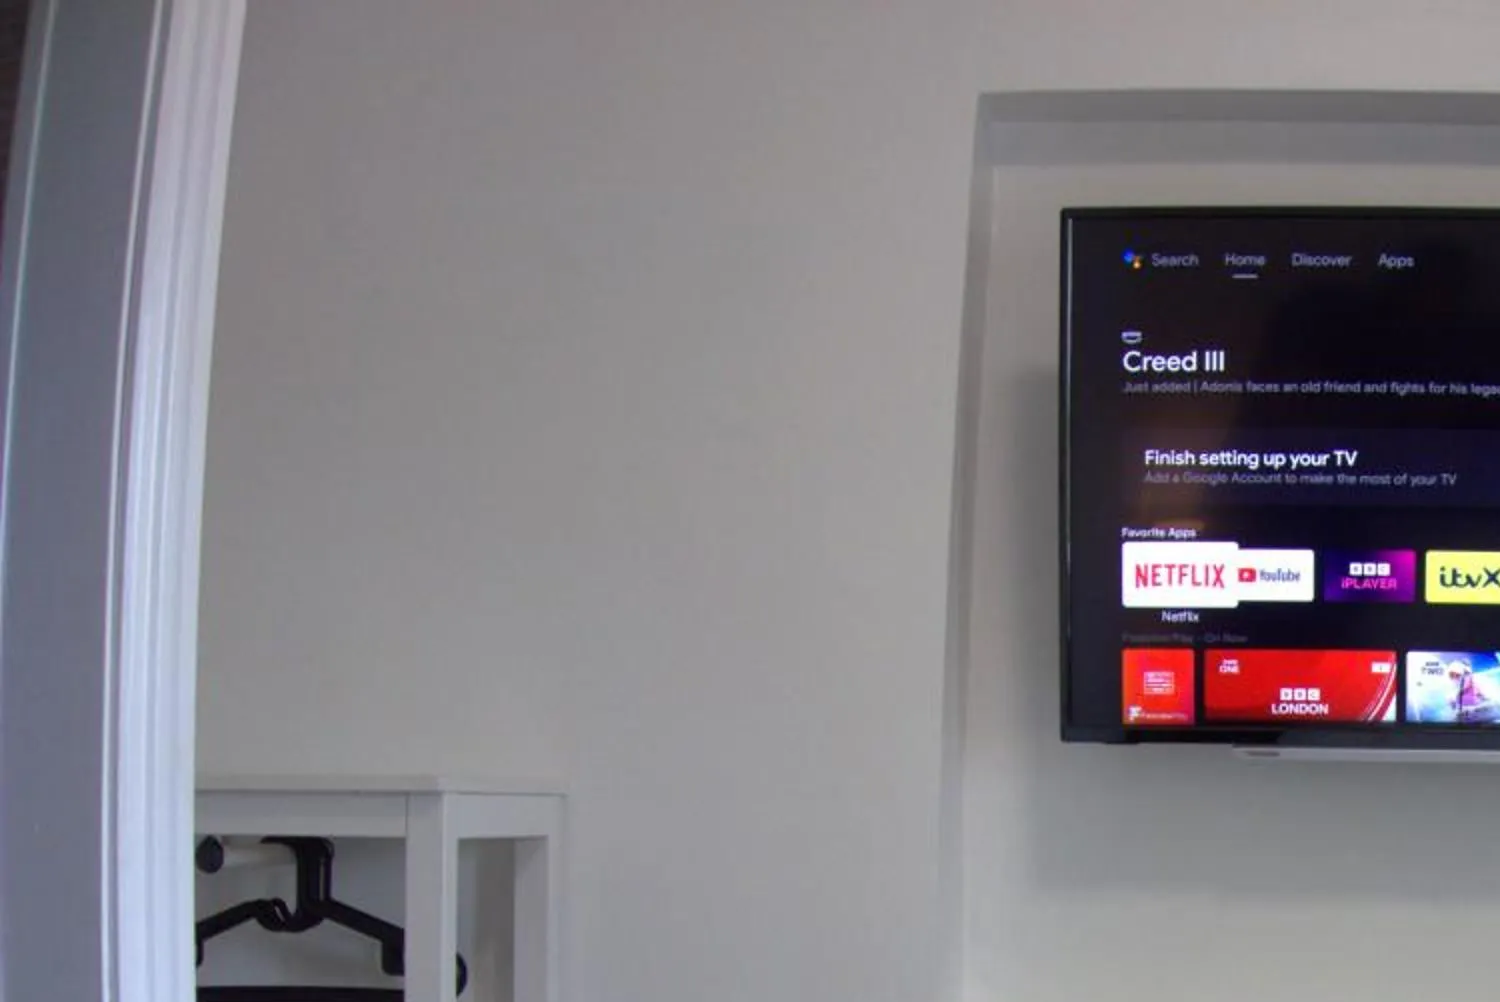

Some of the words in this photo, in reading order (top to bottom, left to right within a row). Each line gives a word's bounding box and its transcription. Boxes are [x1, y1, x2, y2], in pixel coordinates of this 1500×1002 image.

[1151, 253, 1199, 268] Search
[1224, 252, 1266, 267] Home
[1291, 253, 1352, 268] Discover
[1378, 253, 1415, 270] Apps
[1122, 350, 1198, 372] Creed
[1204, 350, 1225, 372] III
[1124, 381, 1149, 393] Just
[1152, 381, 1191, 393] added
[1200, 381, 1243, 393] Adonis
[1247, 381, 1280, 393] faces
[1283, 383, 1299, 393] an
[1301, 381, 1321, 393] old
[1324, 381, 1361, 394] friend
[1363, 381, 1387, 394] and
[1390, 382, 1425, 397] fights
[1429, 382, 1447, 394] for
[1450, 382, 1468, 394] his
[1144, 449, 1195, 465] Finish
[1200, 449, 1259, 470] setting
[1263, 452, 1287, 470] up
[1291, 453, 1329, 470] your
[1333, 450, 1358, 466] TV
[1144, 470, 1170, 483] Add
[1183, 471, 1228, 486] Google
[1231, 471, 1281, 484] Account
[1285, 472, 1298, 484] to
[1301, 472, 1334, 484] make
[1337, 473, 1357, 485] the
[1360, 474, 1391, 485] most
[1393, 473, 1409, 485] of
[1410, 475, 1438, 487] your
[1440, 473, 1458, 485] TV
[1121, 526, 1165, 538] Favorite
[1168, 527, 1197, 540] Apps
[1134, 563, 1226, 589] NETFLIX
[1259, 567, 1301, 583] YouTube
[1161, 610, 1200, 623] Netflix
[1270, 702, 1329, 715] LONDON
